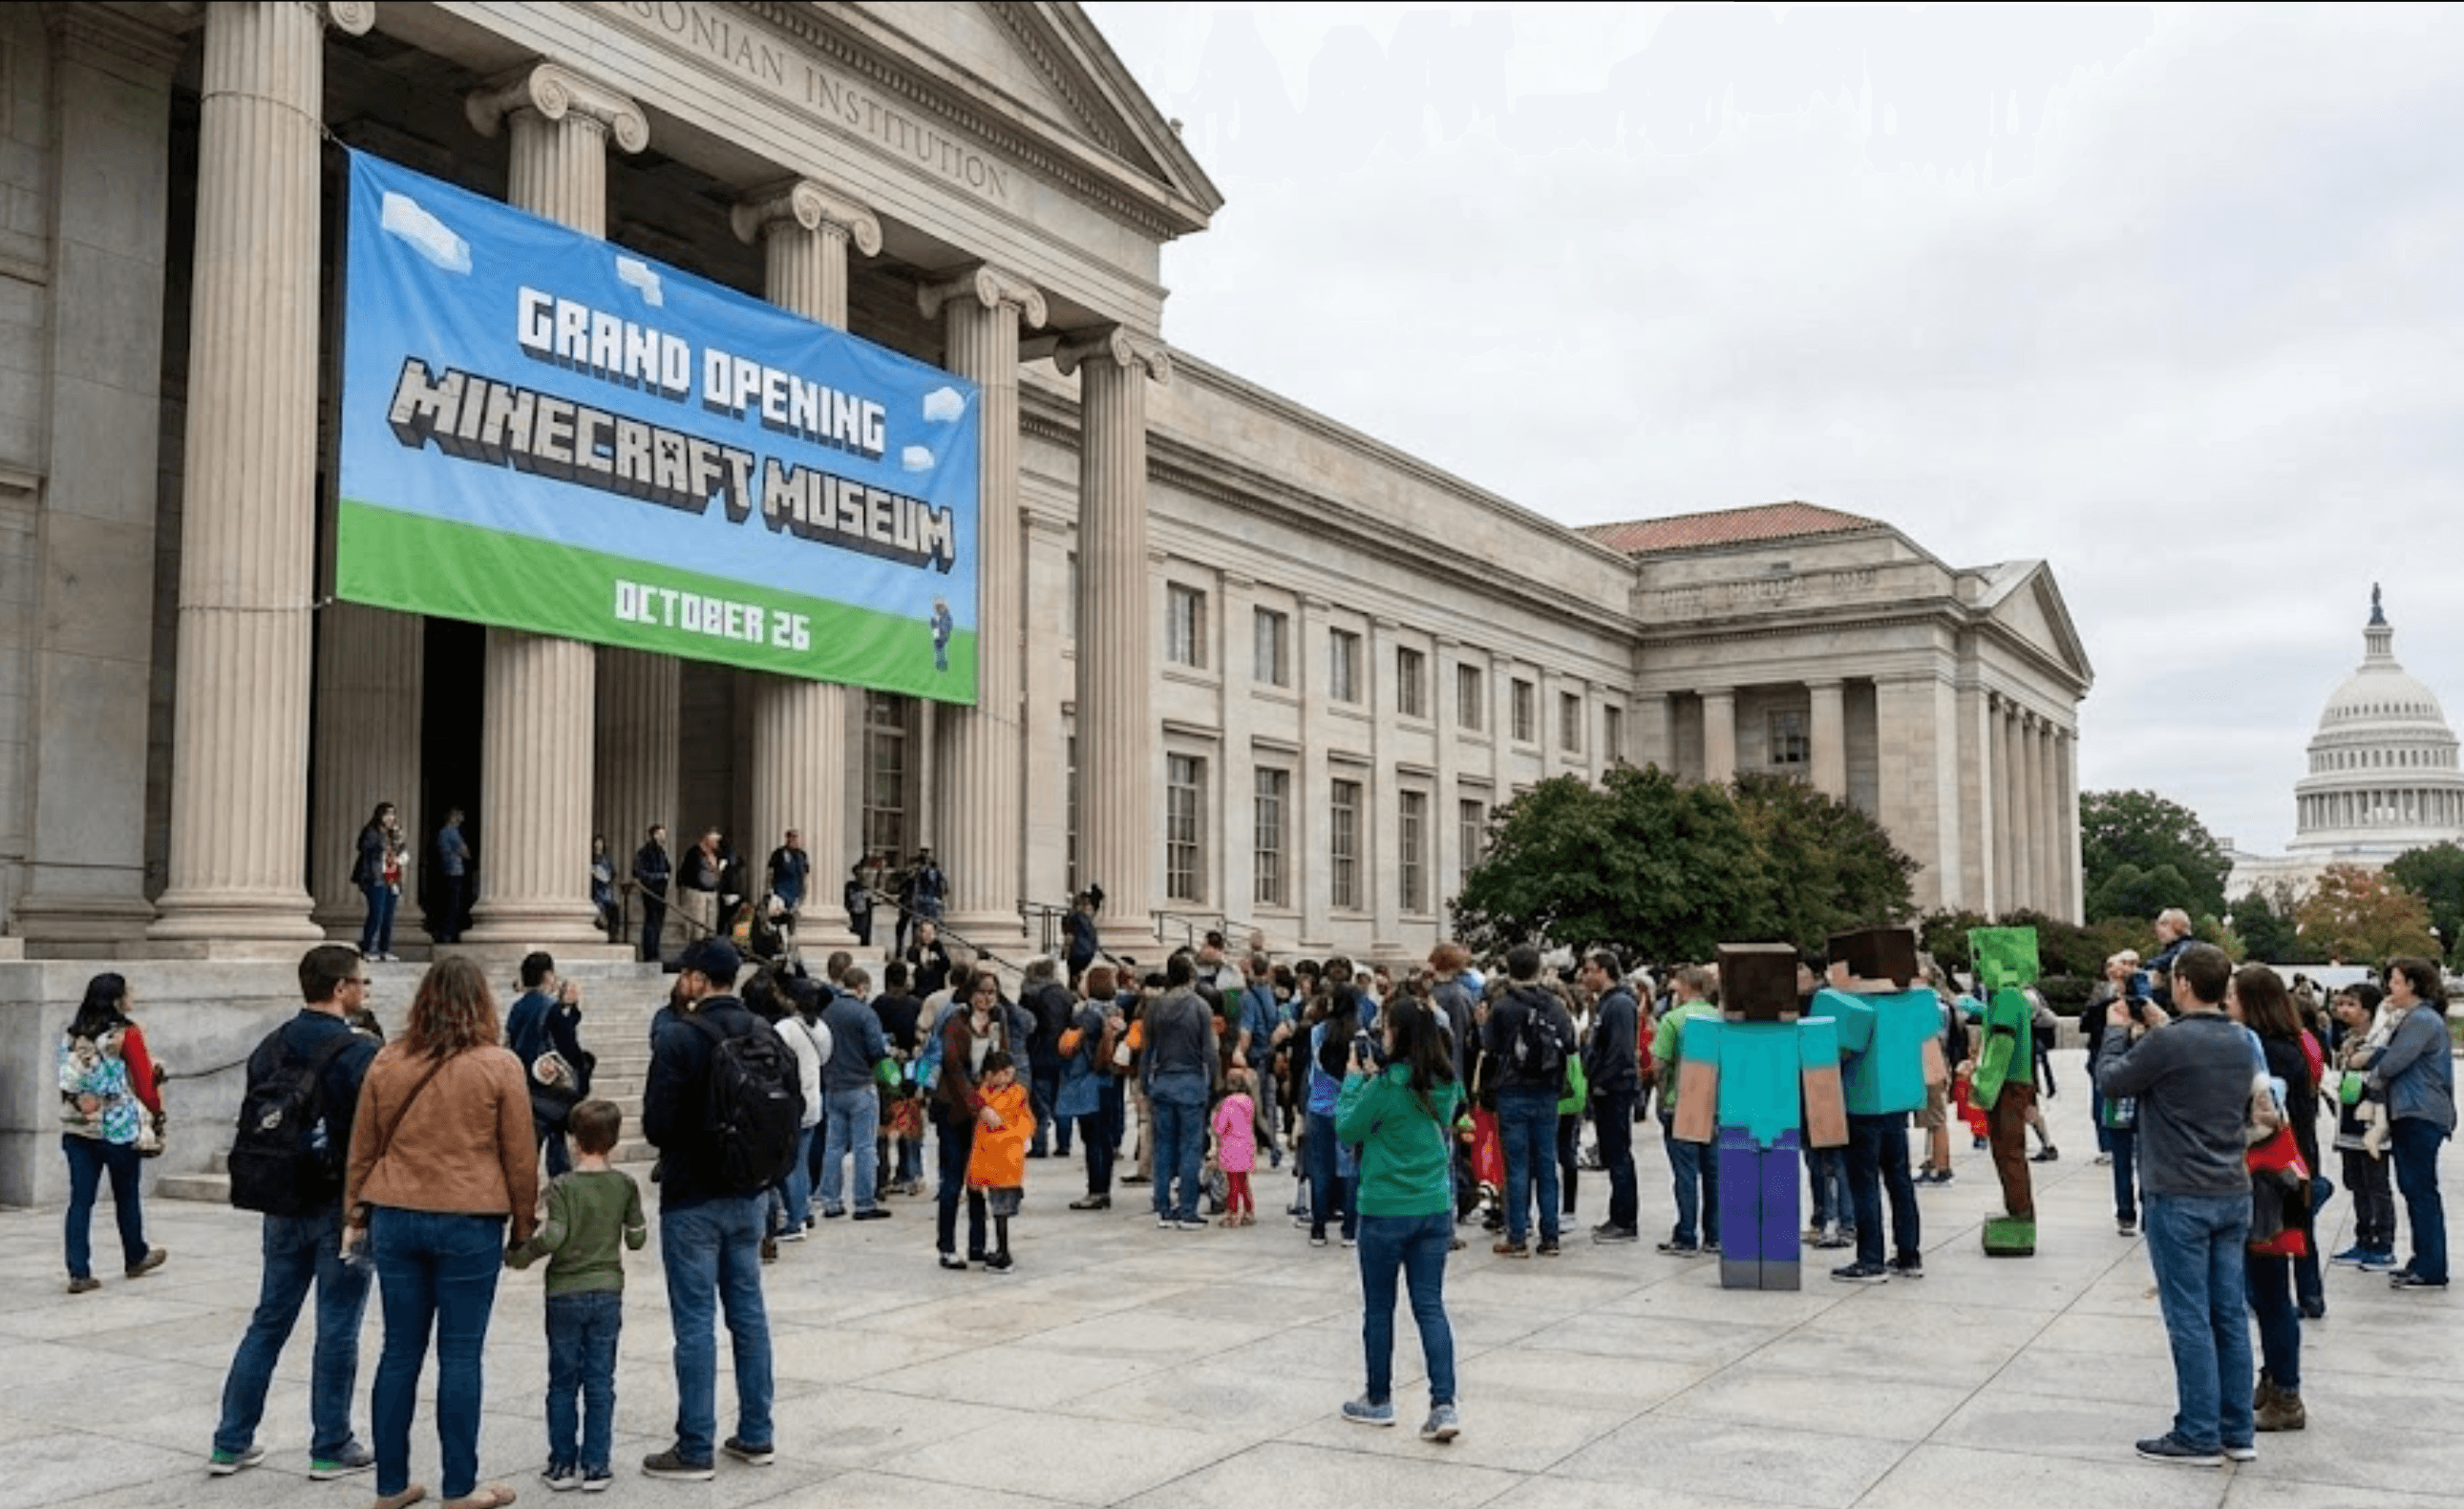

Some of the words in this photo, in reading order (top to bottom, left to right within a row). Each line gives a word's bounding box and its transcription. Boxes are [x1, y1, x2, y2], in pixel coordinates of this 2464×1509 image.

[805, 66, 1008, 197] INSTITUTION
[518, 286, 690, 402] GRAND
[702, 347, 885, 461] OPENING
[388, 355, 754, 525] MINECRAFT
[762, 456, 955, 574] MUSEUM
[615, 579, 765, 644] OCTOBER
[772, 609, 811, 651] 26
